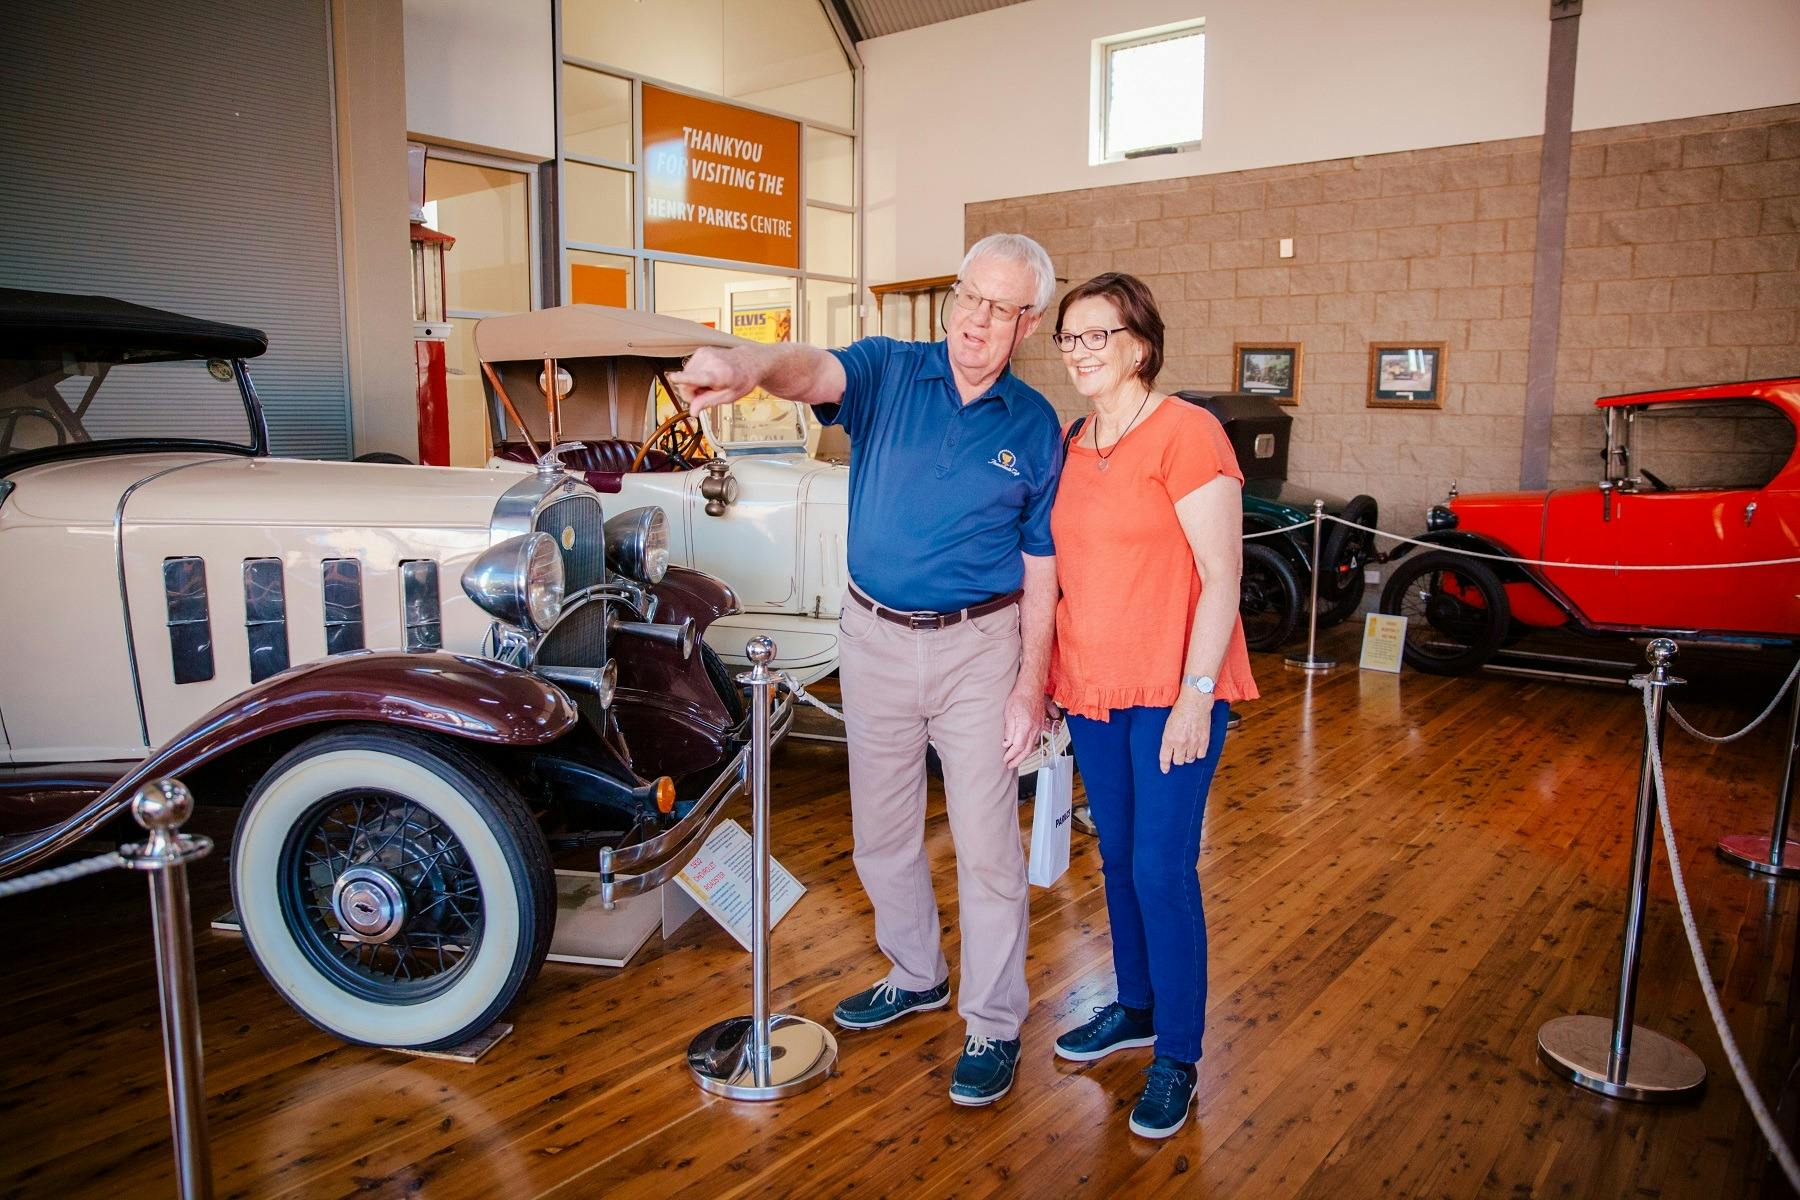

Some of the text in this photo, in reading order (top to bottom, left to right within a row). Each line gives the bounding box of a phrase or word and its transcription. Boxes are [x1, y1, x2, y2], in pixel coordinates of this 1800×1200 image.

[682, 126, 763, 163] THANKYOU
[656, 151, 785, 196] FOR VISITING THE
[647, 196, 793, 238] HENRY PARKES CENTRE
[734, 313, 767, 327] ELVIS
